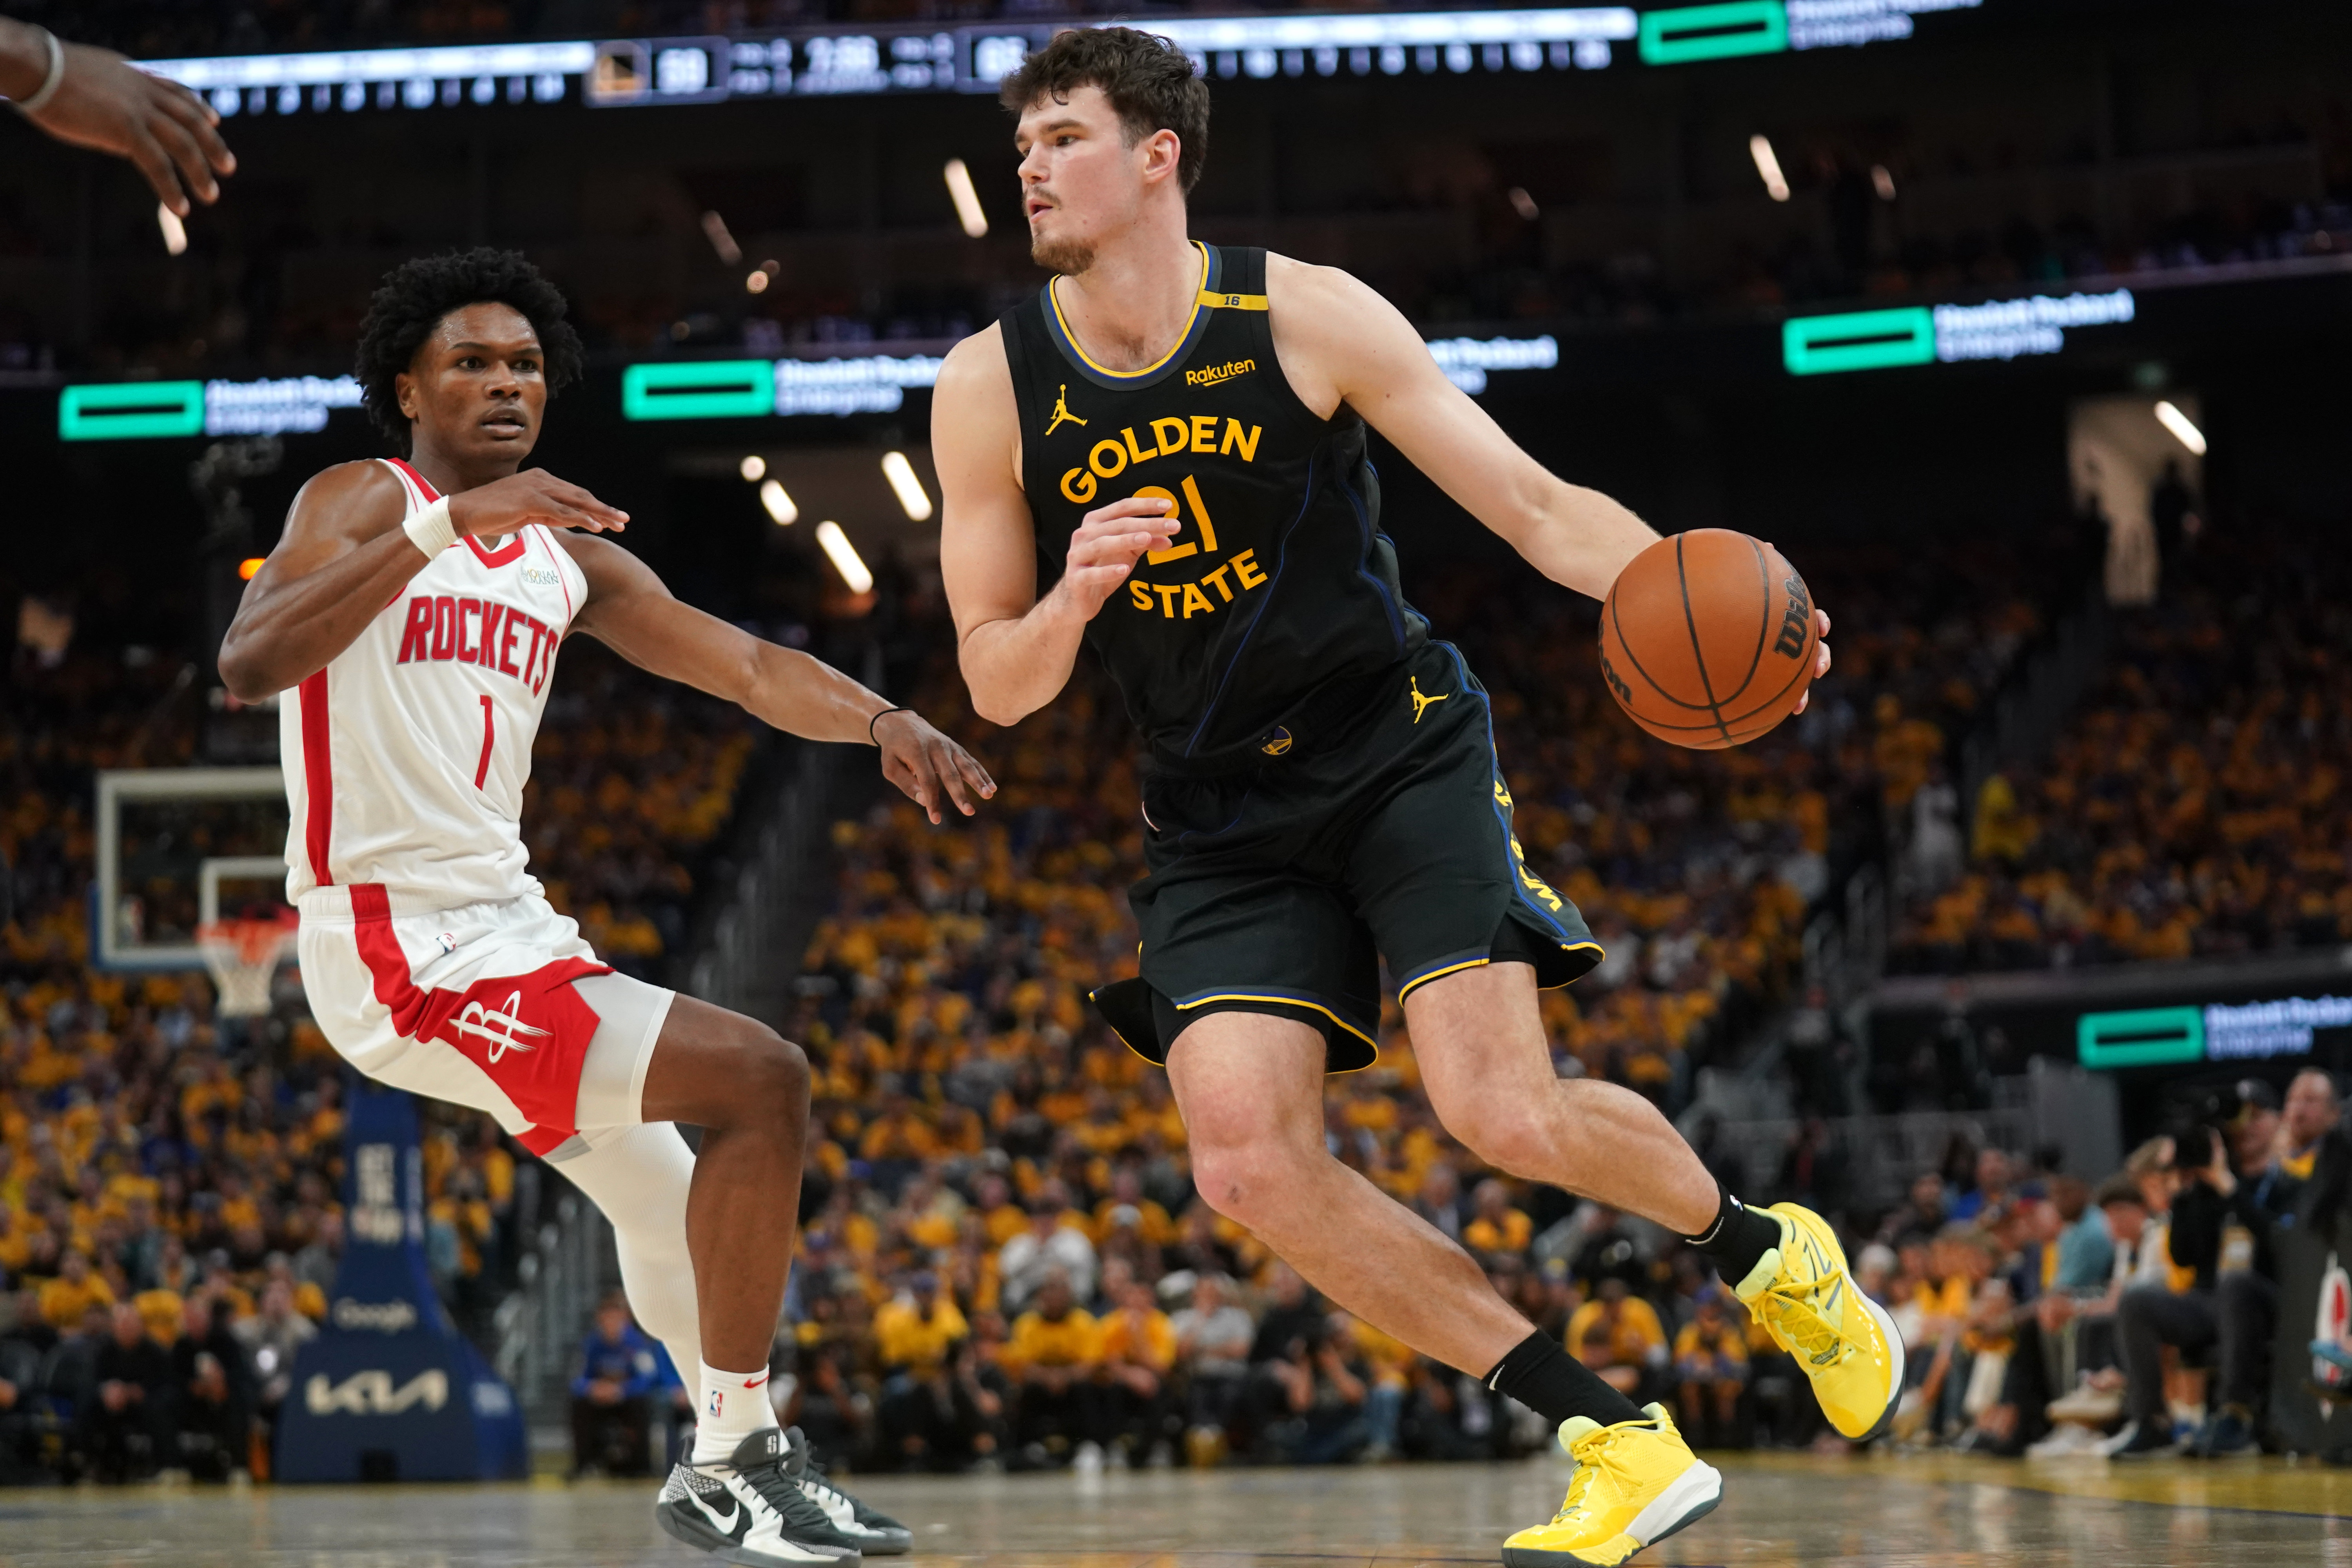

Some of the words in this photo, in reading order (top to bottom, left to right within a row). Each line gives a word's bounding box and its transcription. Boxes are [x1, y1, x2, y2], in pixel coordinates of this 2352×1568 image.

[1224, 296, 1240, 306] 16
[1186, 359, 1256, 386] Rakuten
[1060, 416, 1262, 503] GOLDEN
[1132, 474, 1218, 565] 21
[1129, 548, 1268, 619] STATE
[396, 596, 559, 699] ROCKETS
[474, 694, 494, 791] 1
